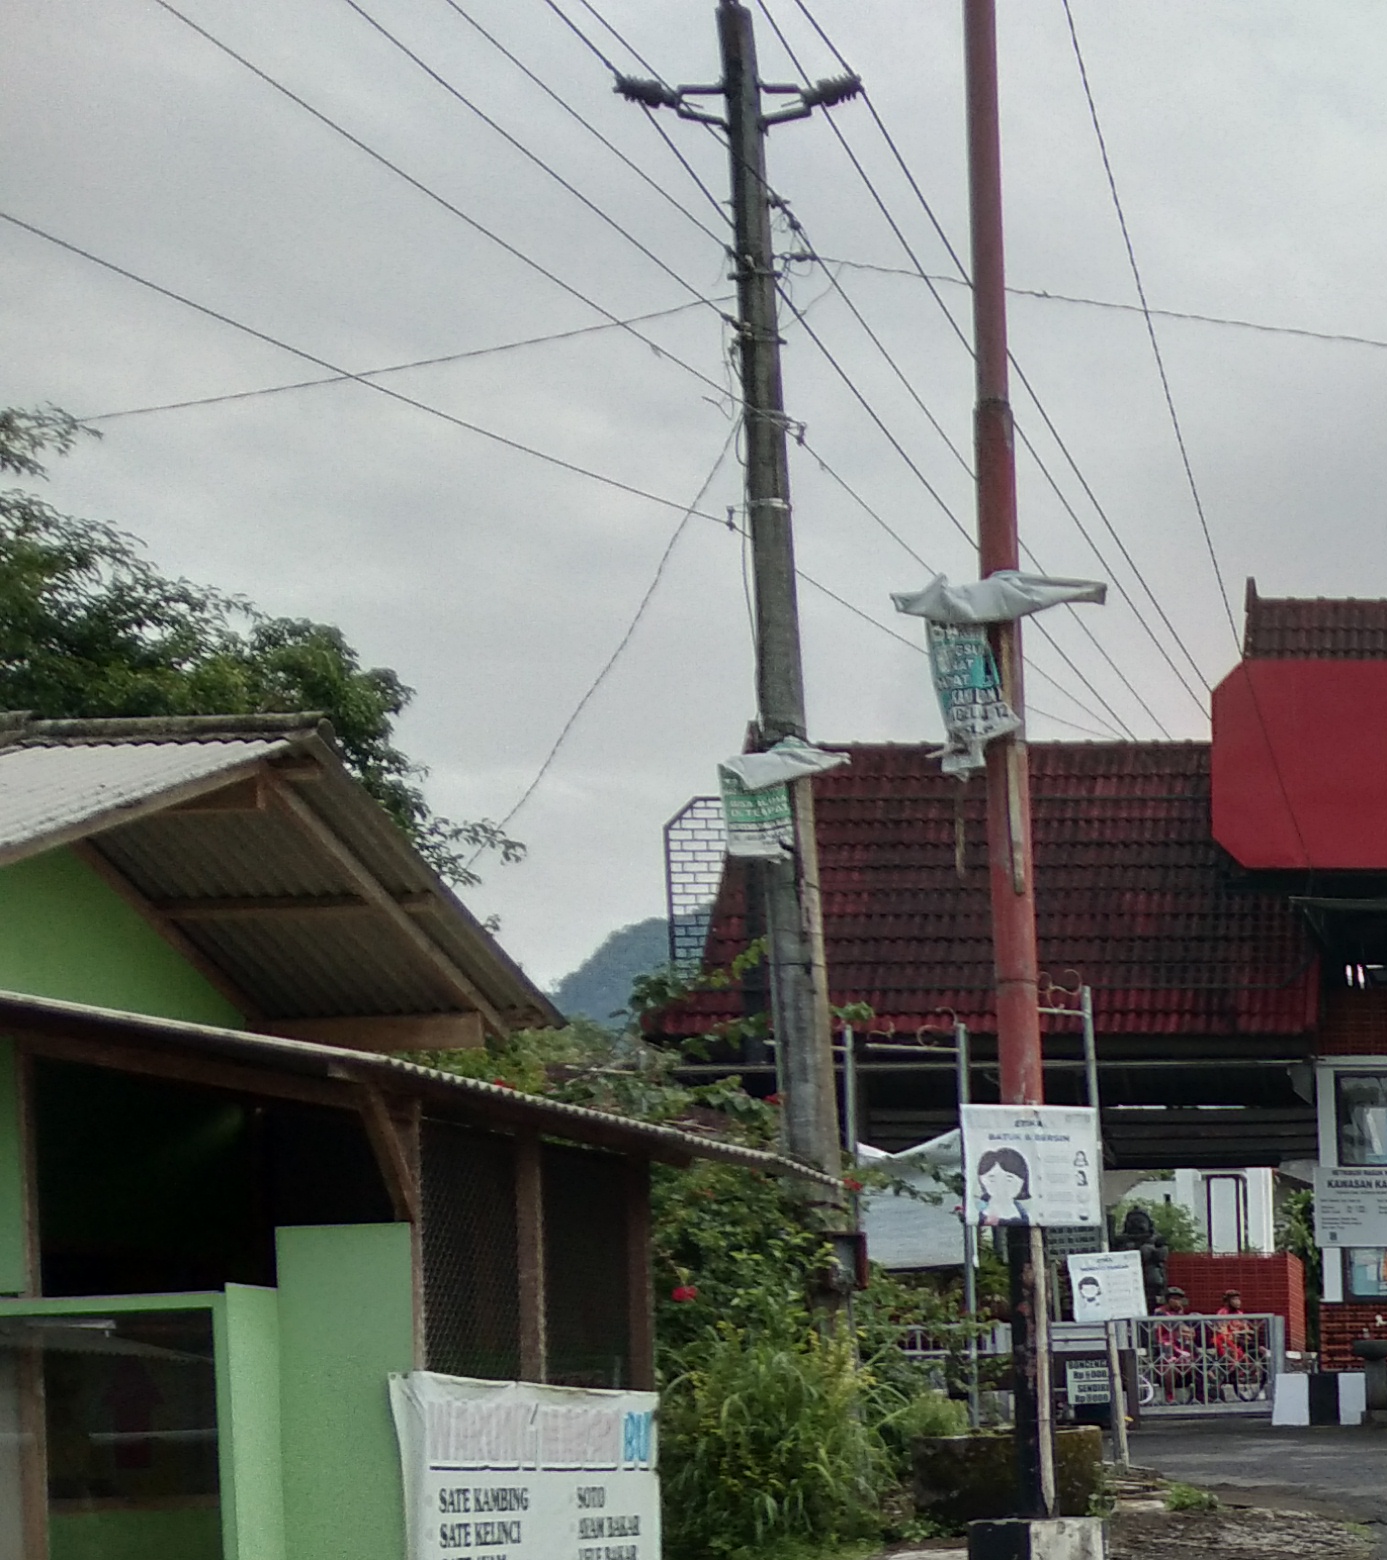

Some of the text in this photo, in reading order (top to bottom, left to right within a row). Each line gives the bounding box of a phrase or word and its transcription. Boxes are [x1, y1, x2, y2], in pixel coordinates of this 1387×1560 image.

[439, 1487, 529, 1513] SATE KAMBING
[577, 1486, 606, 1508] SOTO
[440, 1520, 522, 1548] SATE KELINCI
